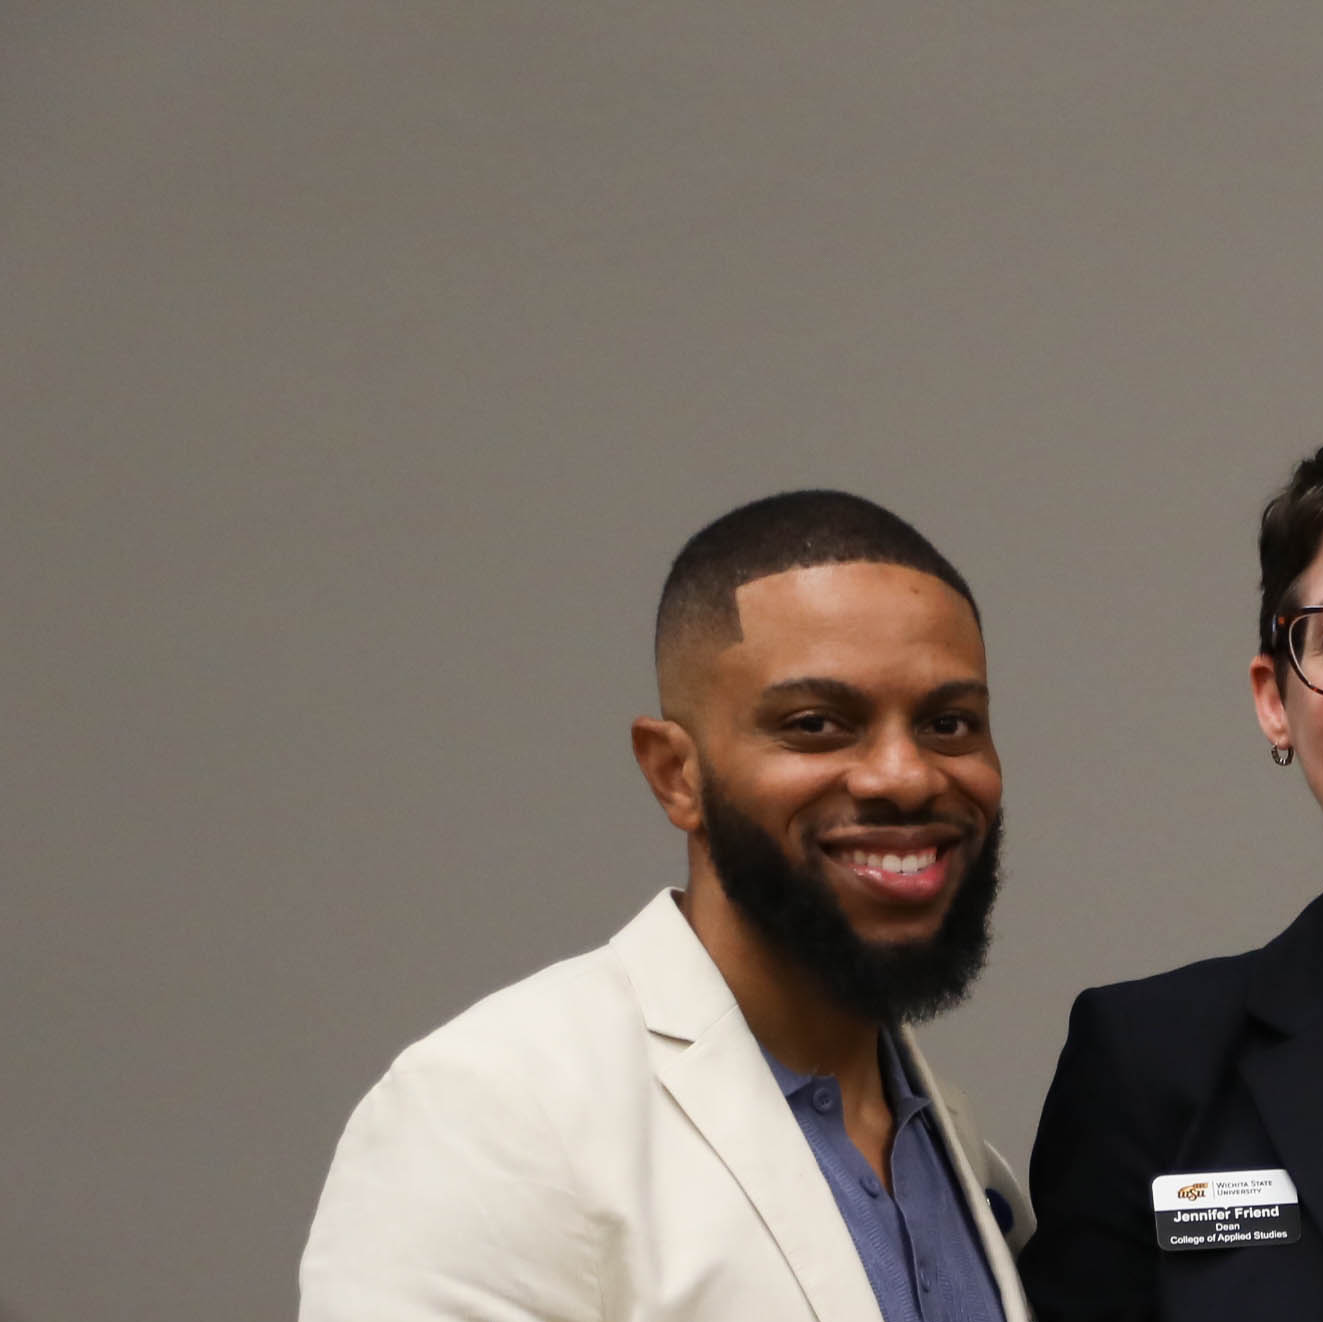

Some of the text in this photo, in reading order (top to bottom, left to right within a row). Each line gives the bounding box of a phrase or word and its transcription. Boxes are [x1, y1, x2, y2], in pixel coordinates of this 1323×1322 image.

[1217, 1188, 1262, 1196] UNIVERSITY
[1173, 1205, 1279, 1223] Jennifer Friend
[1215, 1223, 1240, 1232] Dean
[1170, 1229, 1288, 1246] College of Applied Studies
